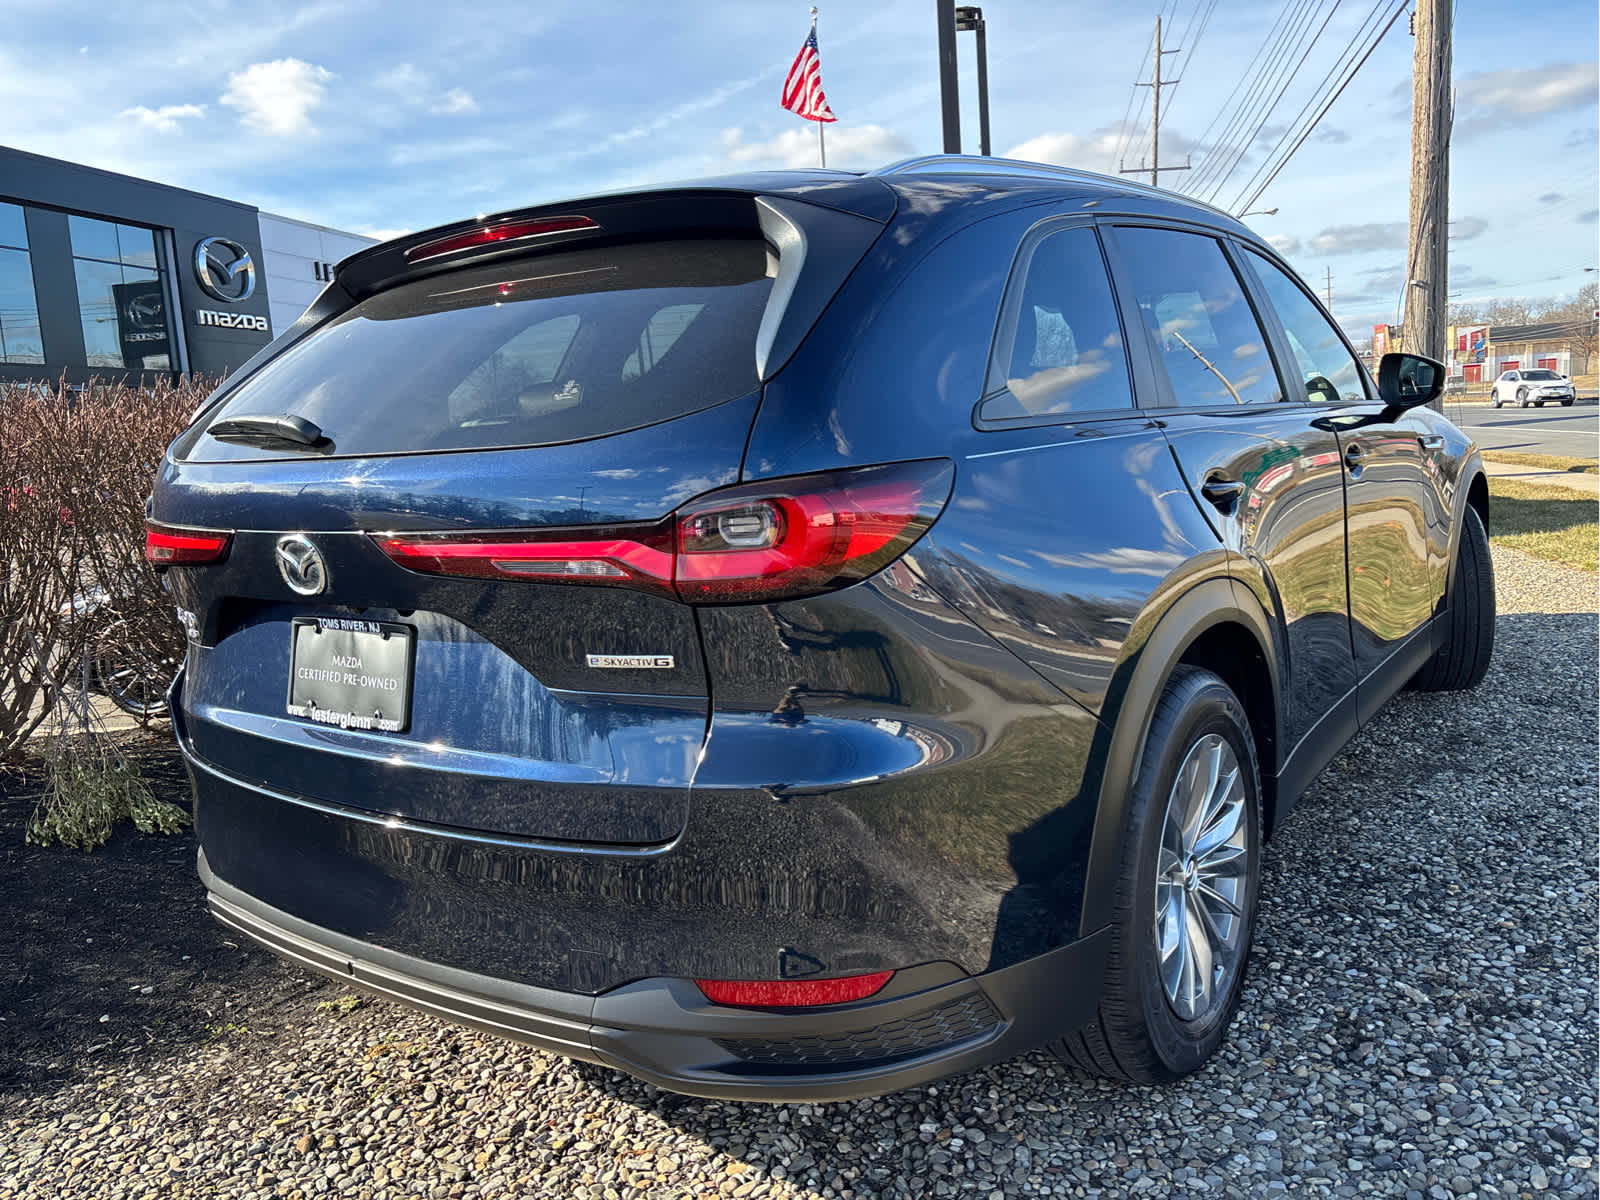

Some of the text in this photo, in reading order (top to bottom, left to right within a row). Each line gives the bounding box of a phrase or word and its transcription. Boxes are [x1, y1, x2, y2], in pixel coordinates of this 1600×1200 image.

[319, 618, 340, 629] TOMS
[369, 621, 381, 633] NJ
[332, 656, 362, 668] MAZDA
[298, 668, 397, 690] CERTIFIED PRE-OWNED
